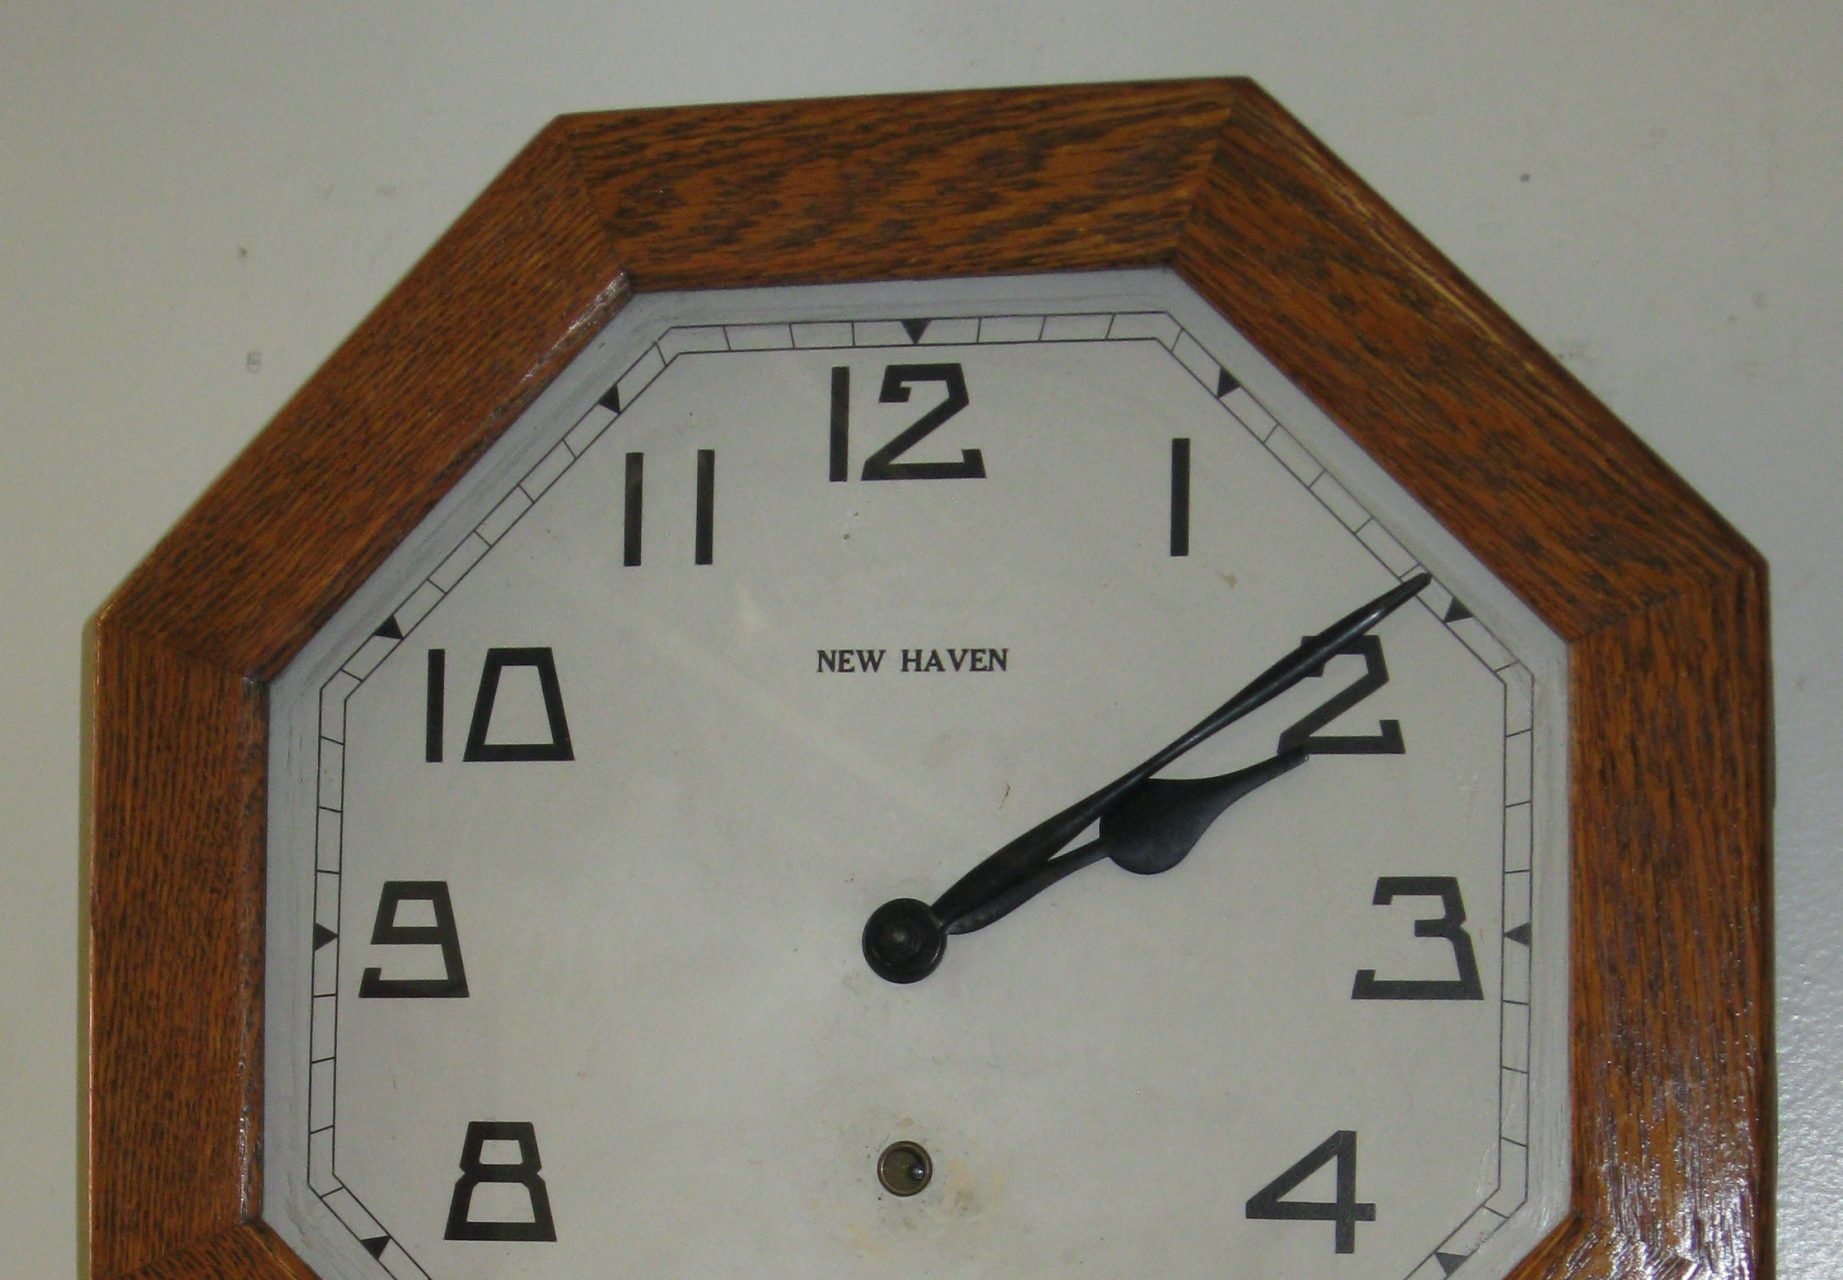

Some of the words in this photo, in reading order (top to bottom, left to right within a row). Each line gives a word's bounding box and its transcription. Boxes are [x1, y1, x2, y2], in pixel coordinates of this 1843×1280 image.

[830, 363, 986, 482] 12
[624, 450, 715, 566] 11
[1171, 438, 1190, 556] 1
[426, 647, 574, 762] 10
[816, 649, 887, 673] NEW
[901, 648, 1009, 672] HAVEN
[1277, 635, 1406, 754] 2
[359, 881, 469, 998] 9
[1352, 877, 1484, 1000] 3
[444, 1121, 557, 1242] 8
[1246, 1131, 1375, 1254] 4
